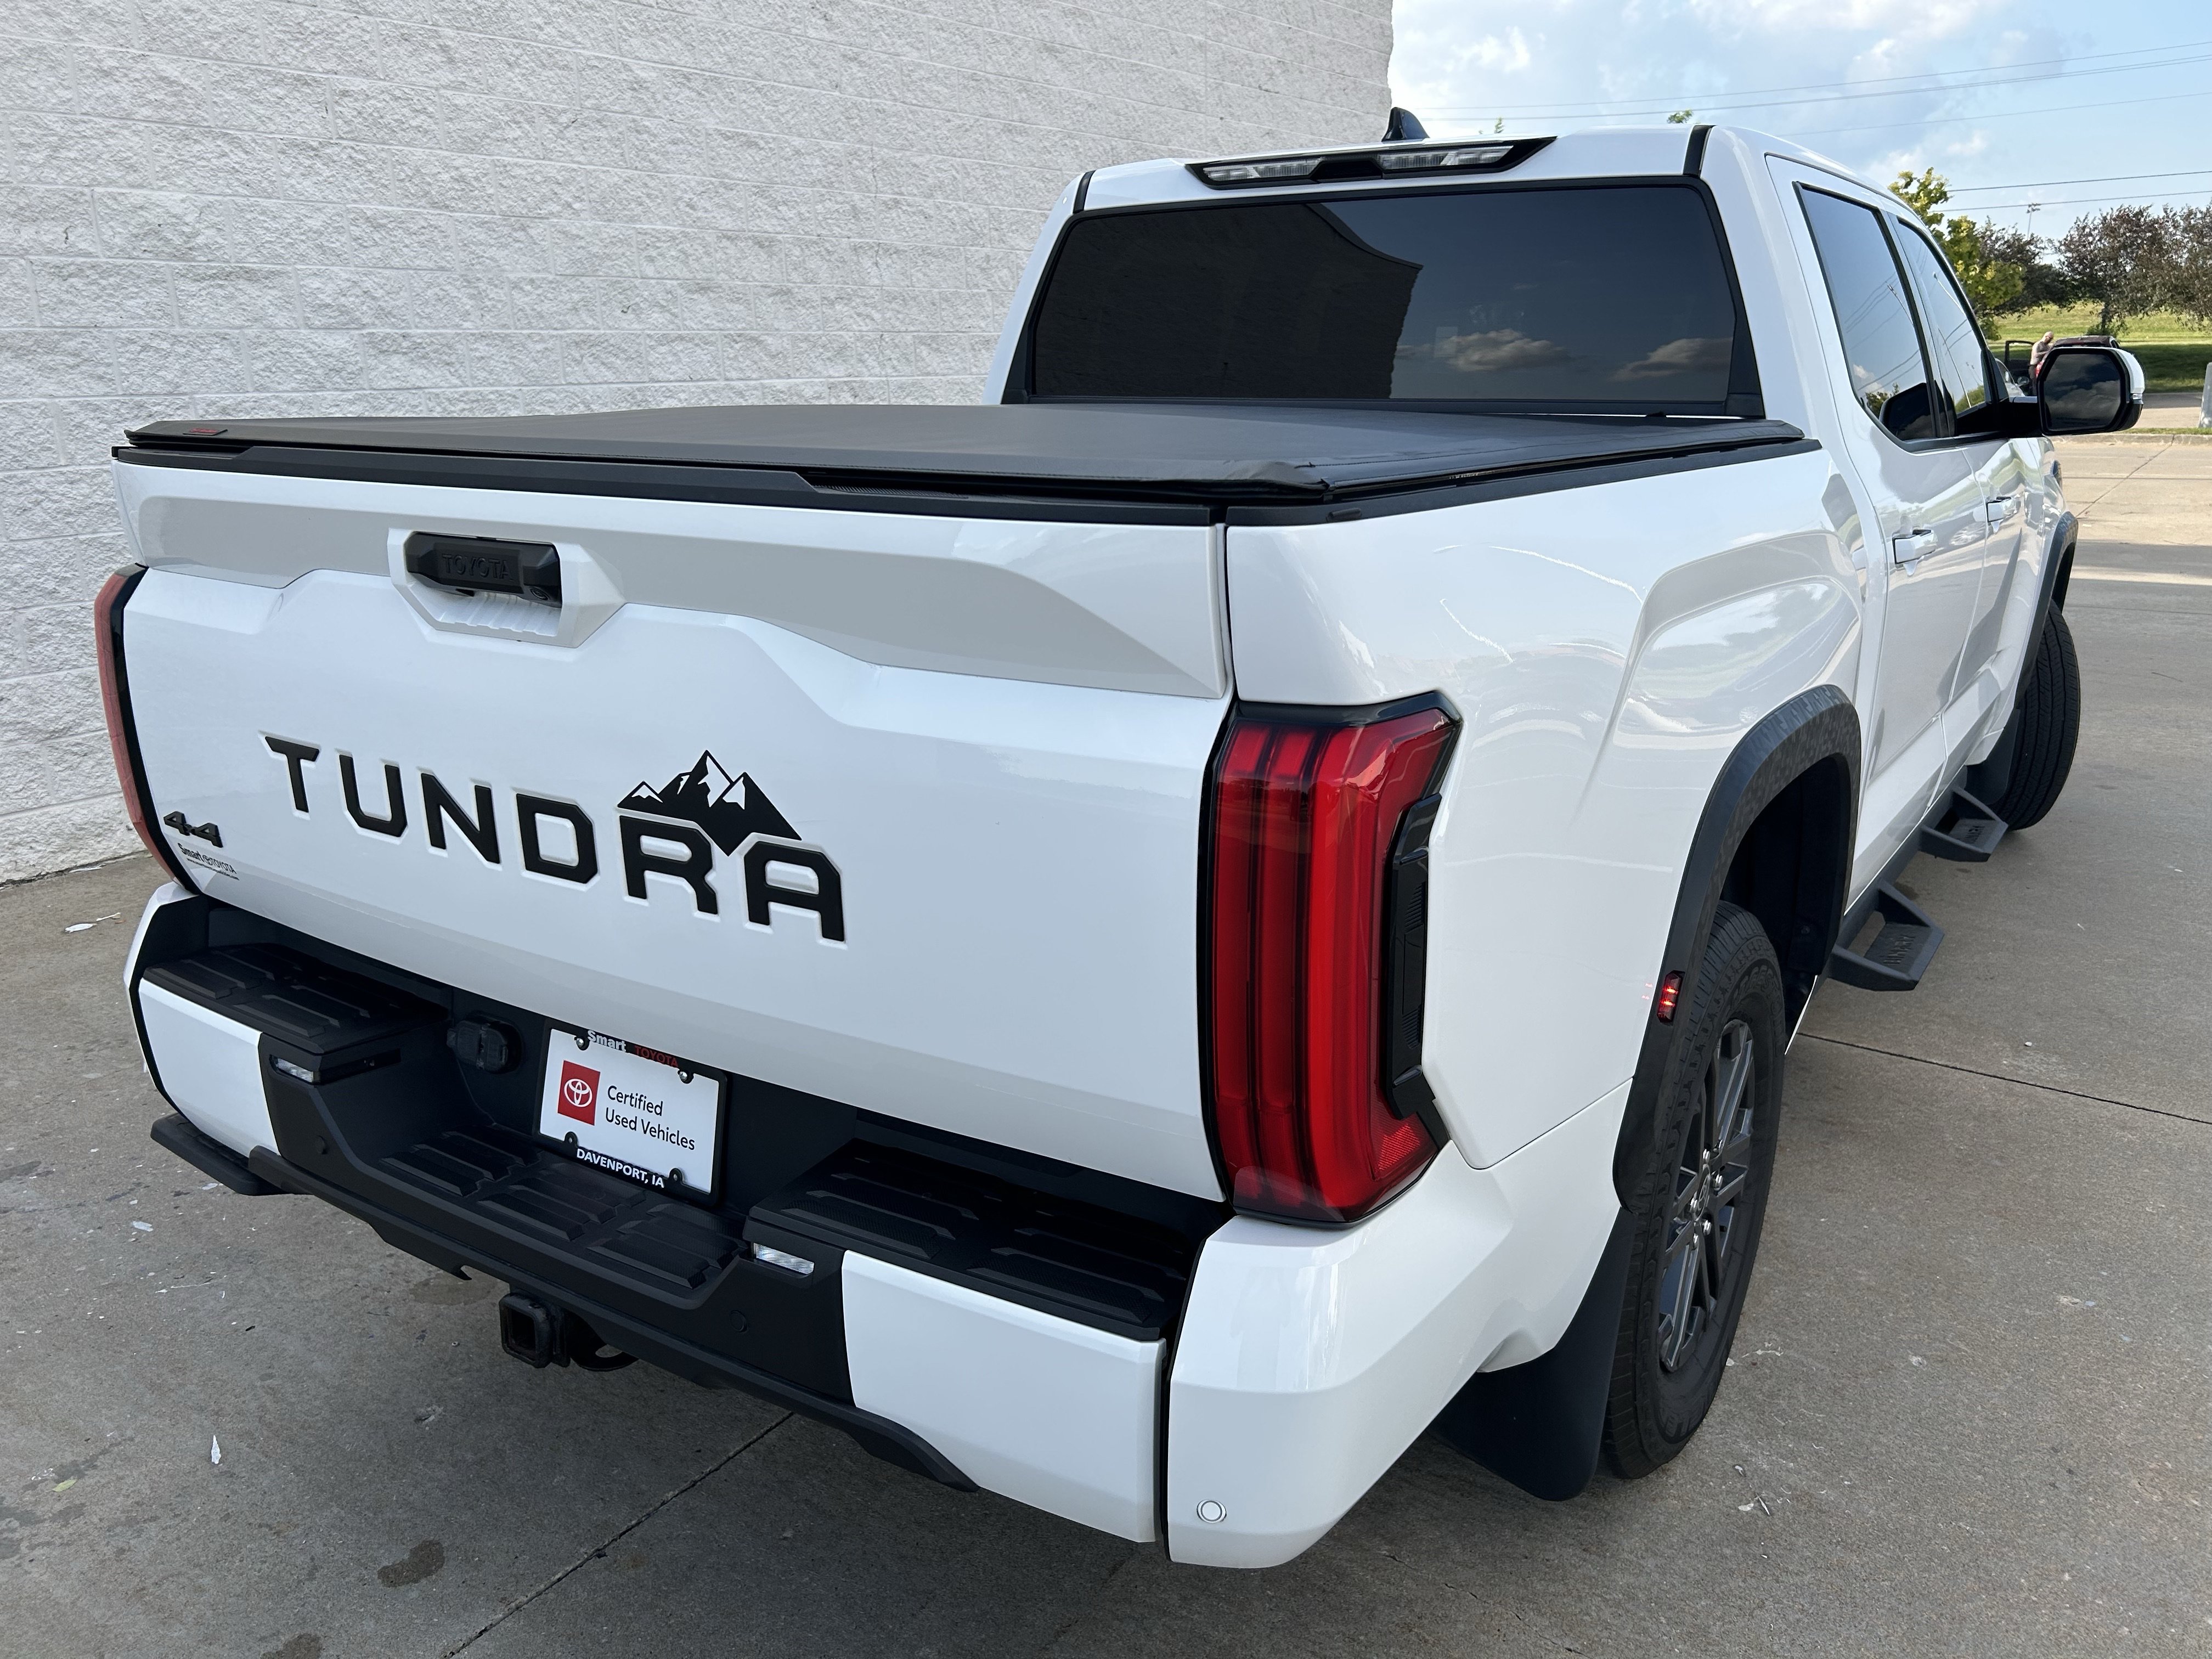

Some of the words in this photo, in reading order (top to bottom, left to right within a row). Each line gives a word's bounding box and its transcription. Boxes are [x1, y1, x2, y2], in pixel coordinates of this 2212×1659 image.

[442, 554, 512, 580] TOYOTA
[264, 734, 847, 943] TUNDRA
[177, 843, 205, 862] Smart
[210, 857, 237, 874] TOYOTA
[587, 1029, 627, 1052] Smart
[634, 1045, 679, 1068] TOYOTA
[607, 1085, 663, 1116] Certified
[605, 1107, 637, 1131] Used
[641, 1118, 696, 1151] Vehicles
[576, 1148, 648, 1184] DAVENPORT,
[651, 1174, 665, 1189] IA
